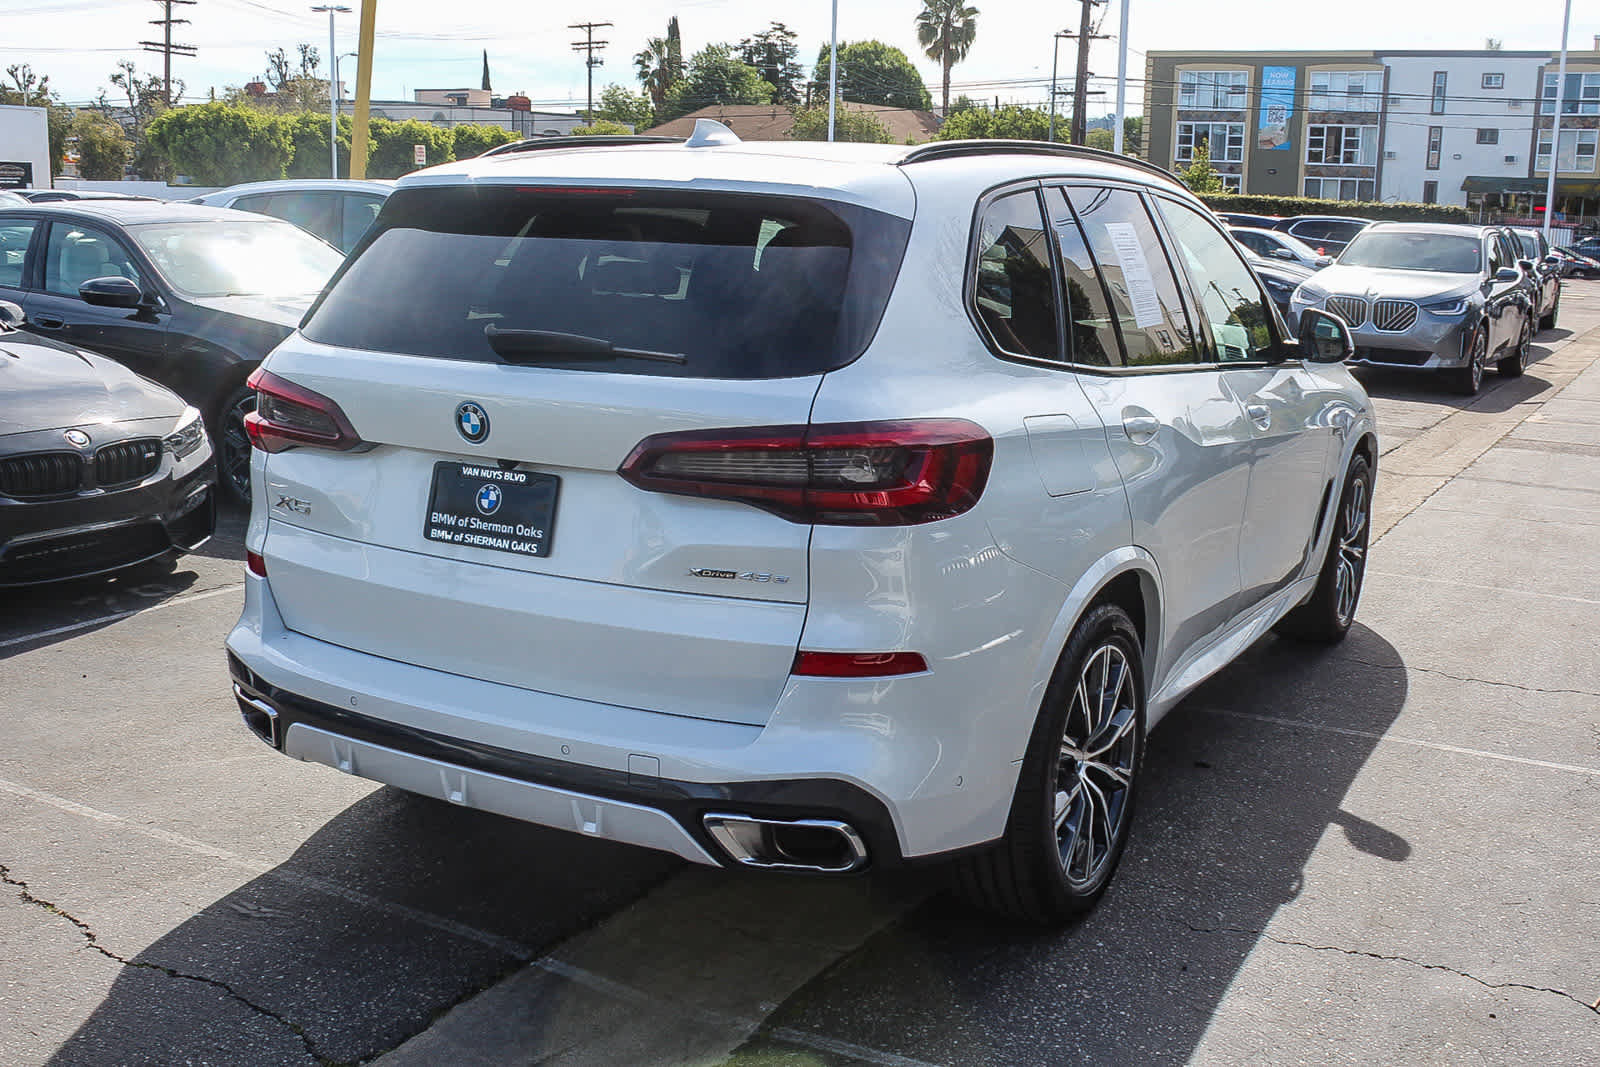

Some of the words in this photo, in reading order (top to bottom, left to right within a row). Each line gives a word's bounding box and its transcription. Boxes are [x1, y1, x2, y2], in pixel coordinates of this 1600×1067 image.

[462, 466, 480, 477] VAN
[480, 469, 503, 480] NUYS
[504, 471, 527, 482] BLVD
[274, 495, 312, 513] X5
[431, 512, 457, 525] BMW
[458, 517, 469, 527] of
[469, 517, 514, 534] Sherman
[516, 524, 544, 539] Oaks
[430, 528, 454, 540] BMW
[454, 532, 464, 541] of
[464, 533, 511, 549] SHERMAN
[511, 541, 538, 553] OAKS
